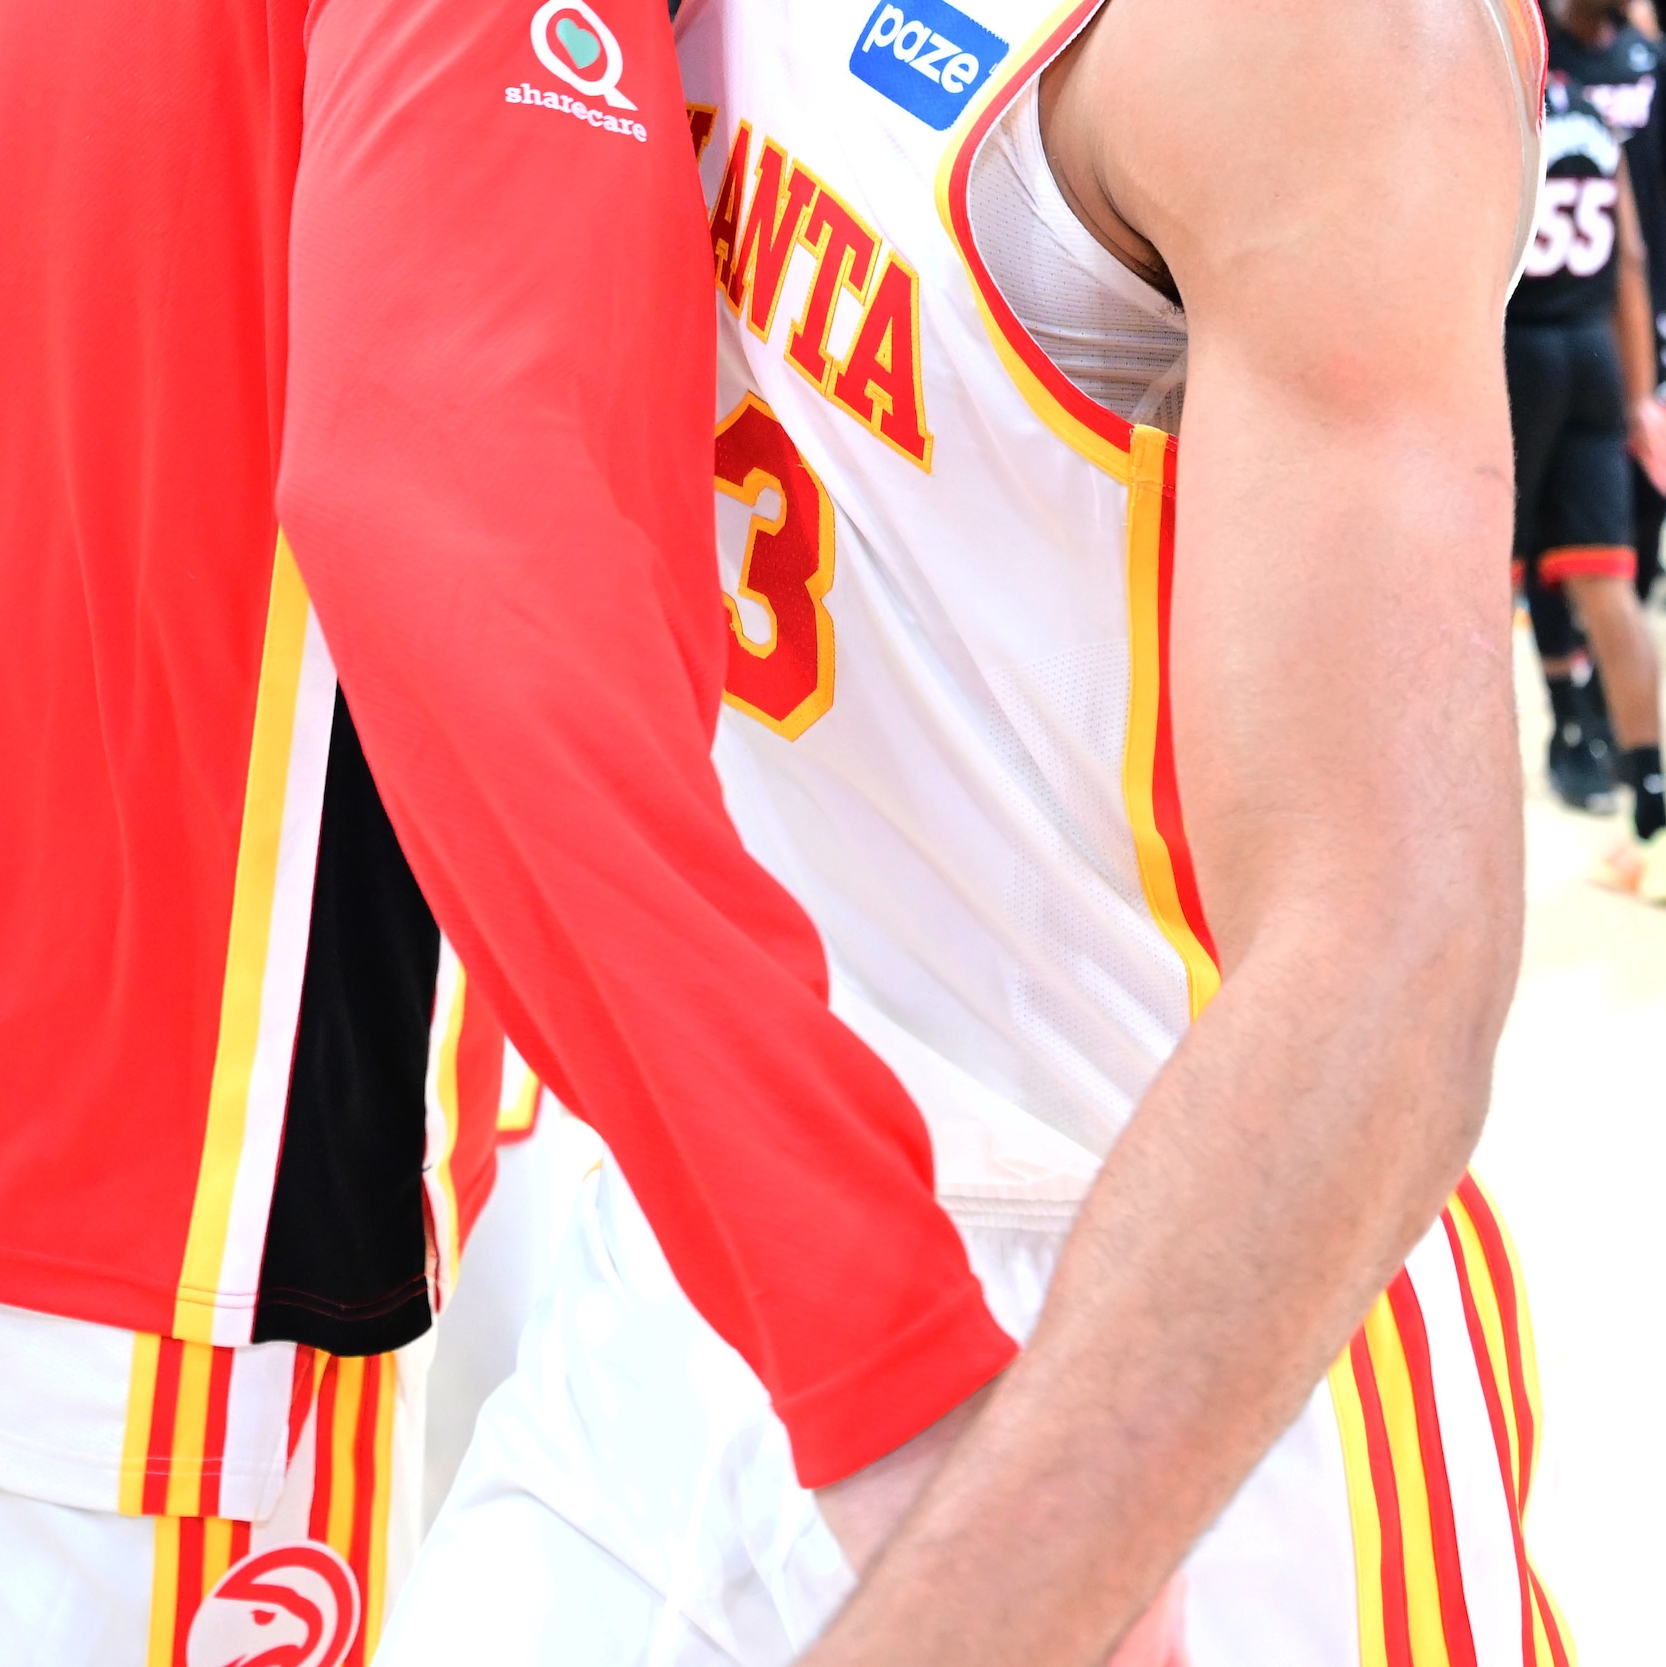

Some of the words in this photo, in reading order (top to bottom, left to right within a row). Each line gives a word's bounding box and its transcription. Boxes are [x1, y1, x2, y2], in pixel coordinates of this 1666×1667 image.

[861, 3, 980, 94] paze
[504, 82, 648, 143] sharecare
[1524, 176, 1620, 277] 55
